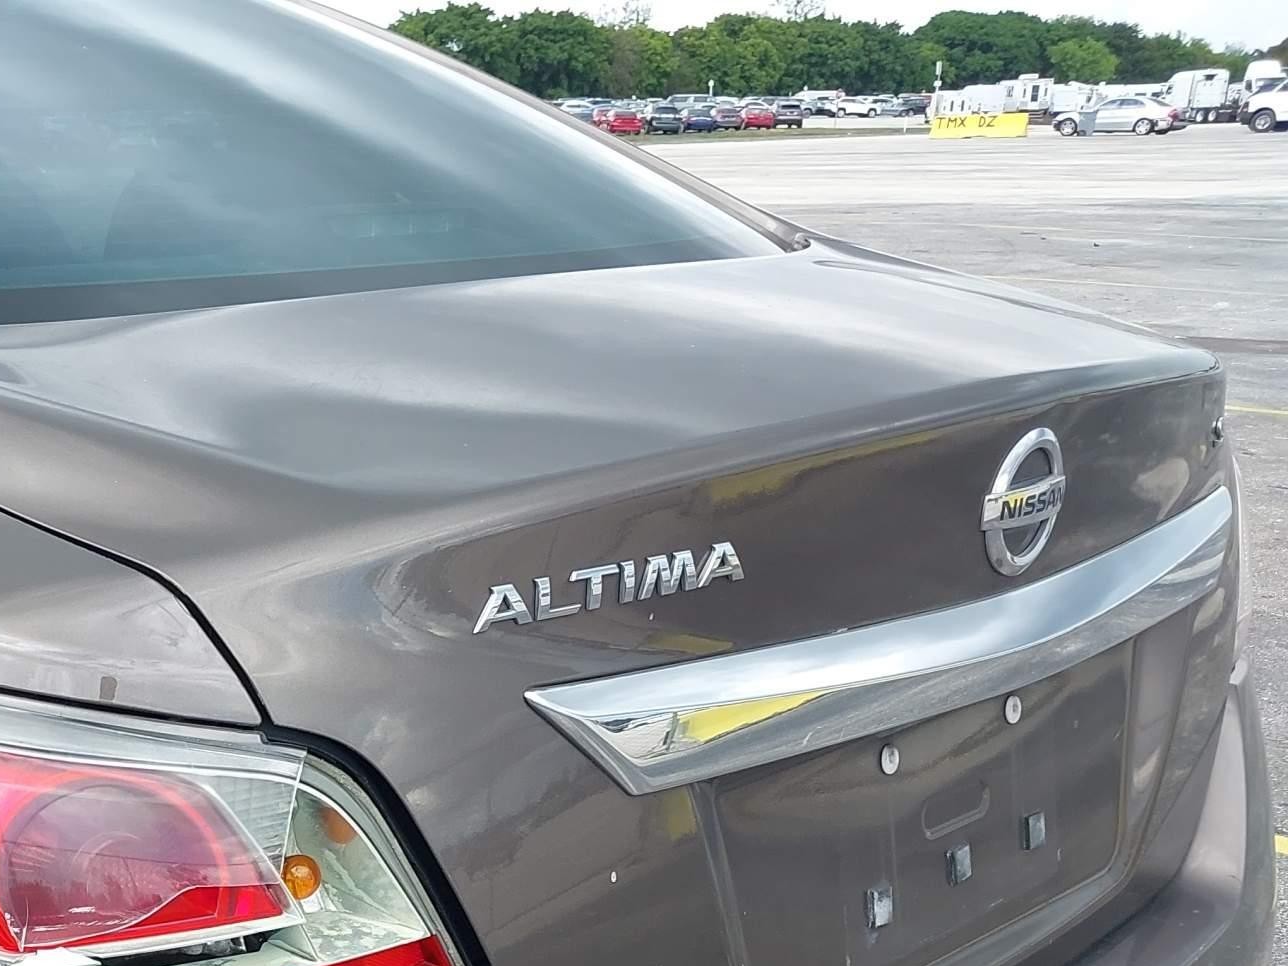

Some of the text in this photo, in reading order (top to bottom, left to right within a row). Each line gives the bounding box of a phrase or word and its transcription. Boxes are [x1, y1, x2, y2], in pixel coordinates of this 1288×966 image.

[936, 115, 998, 129] TMX DZ
[1000, 486, 1064, 521] NISSAN
[472, 541, 745, 634] ALTIMA
